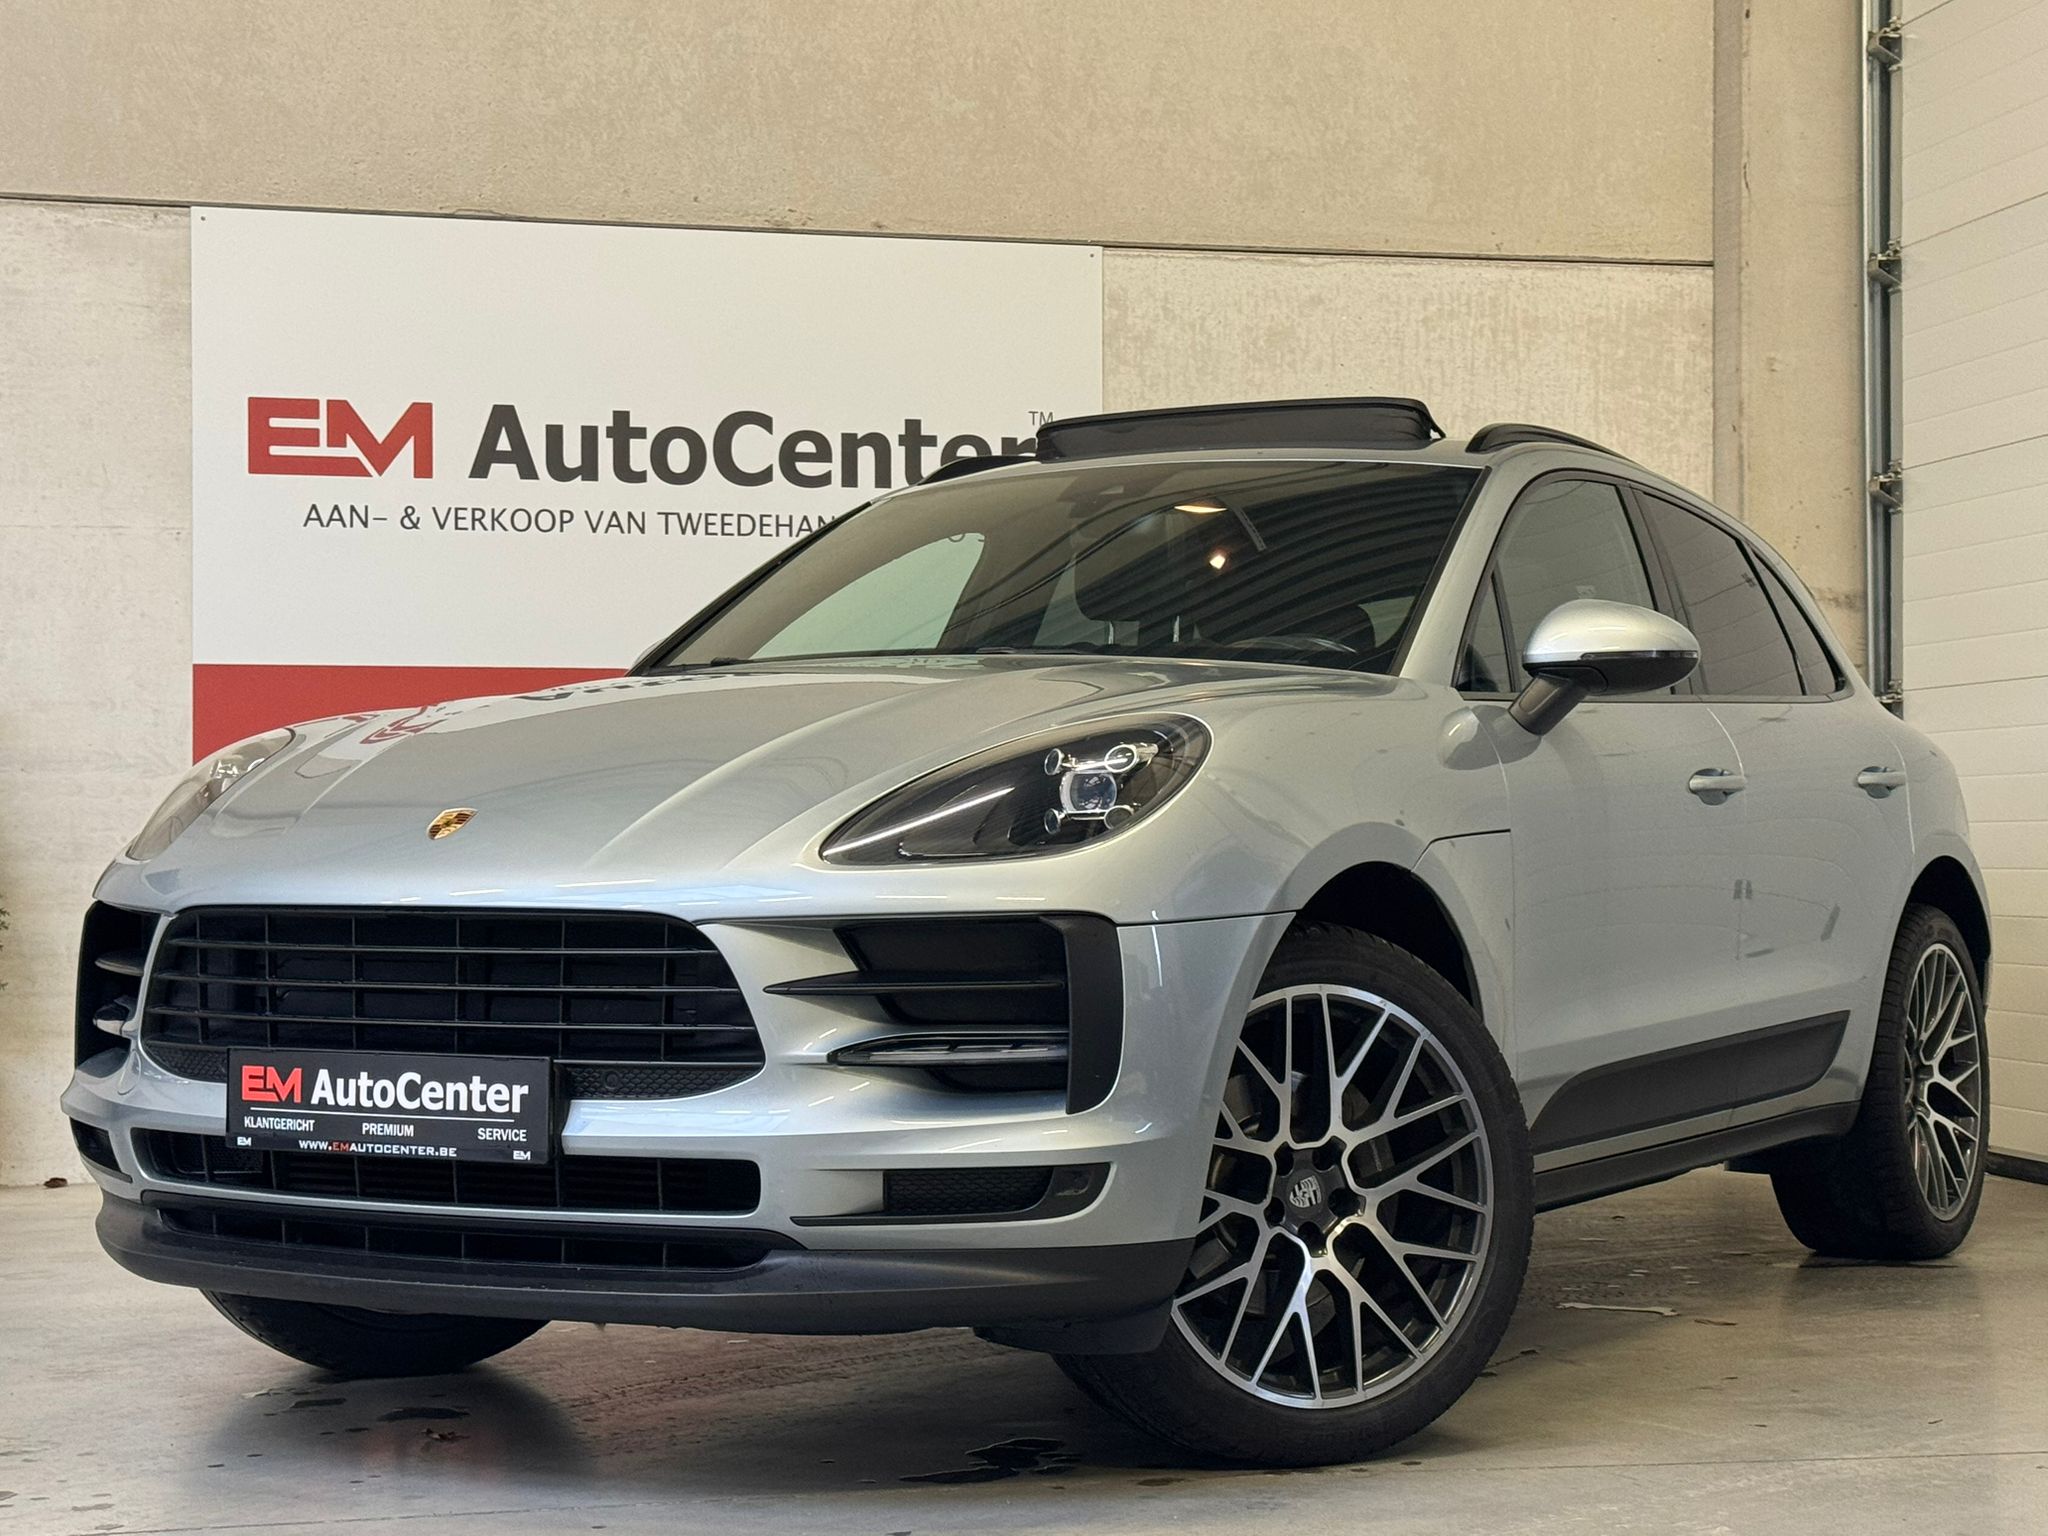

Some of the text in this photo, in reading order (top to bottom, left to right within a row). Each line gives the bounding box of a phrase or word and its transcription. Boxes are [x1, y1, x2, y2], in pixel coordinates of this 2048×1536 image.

[247, 396, 434, 479] EM
[399, 506, 421, 531] &
[432, 506, 575, 534] VERKOOP
[585, 510, 647, 535] VAN
[241, 1065, 529, 1114] EM AutoCenter
[244, 1116, 527, 1142] KLANTGERICHT PREMIUM SERVICE
